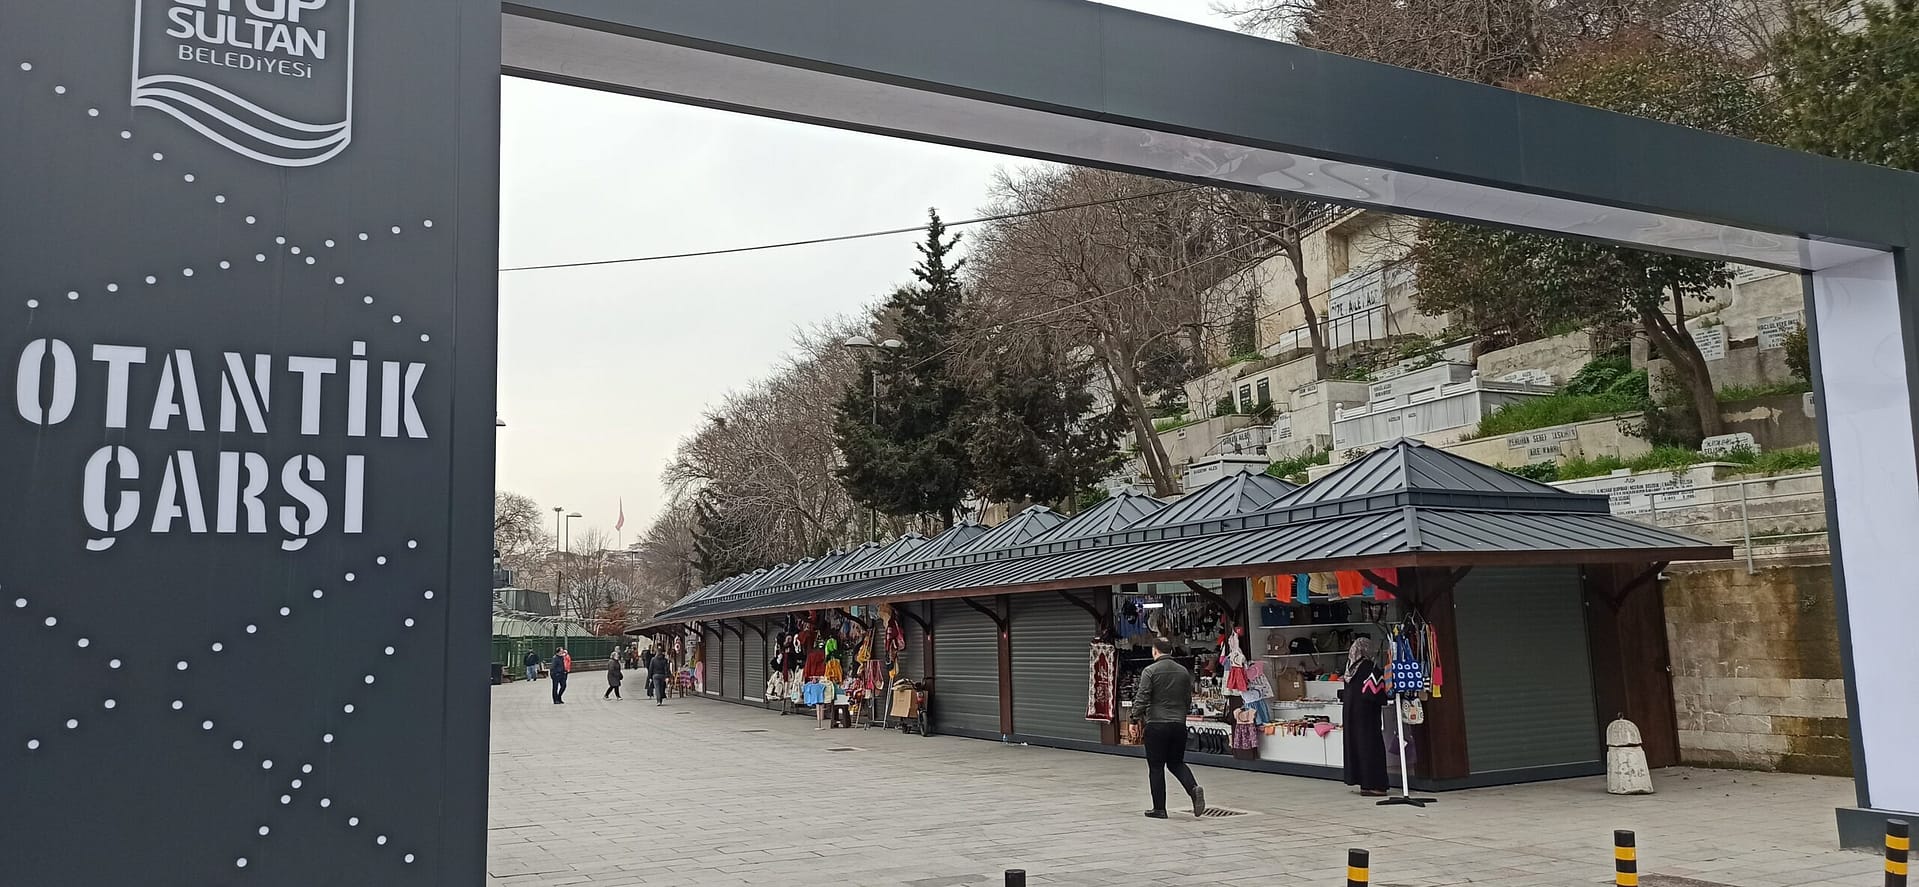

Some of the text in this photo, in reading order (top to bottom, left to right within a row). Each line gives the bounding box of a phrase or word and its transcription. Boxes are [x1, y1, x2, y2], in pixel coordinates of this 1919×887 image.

[166, 7, 326, 60] SULTAN
[178, 44, 312, 79] BELEDİYESİ
[16, 338, 429, 439] OTANTİK
[82, 445, 365, 551] ÇARŞI
